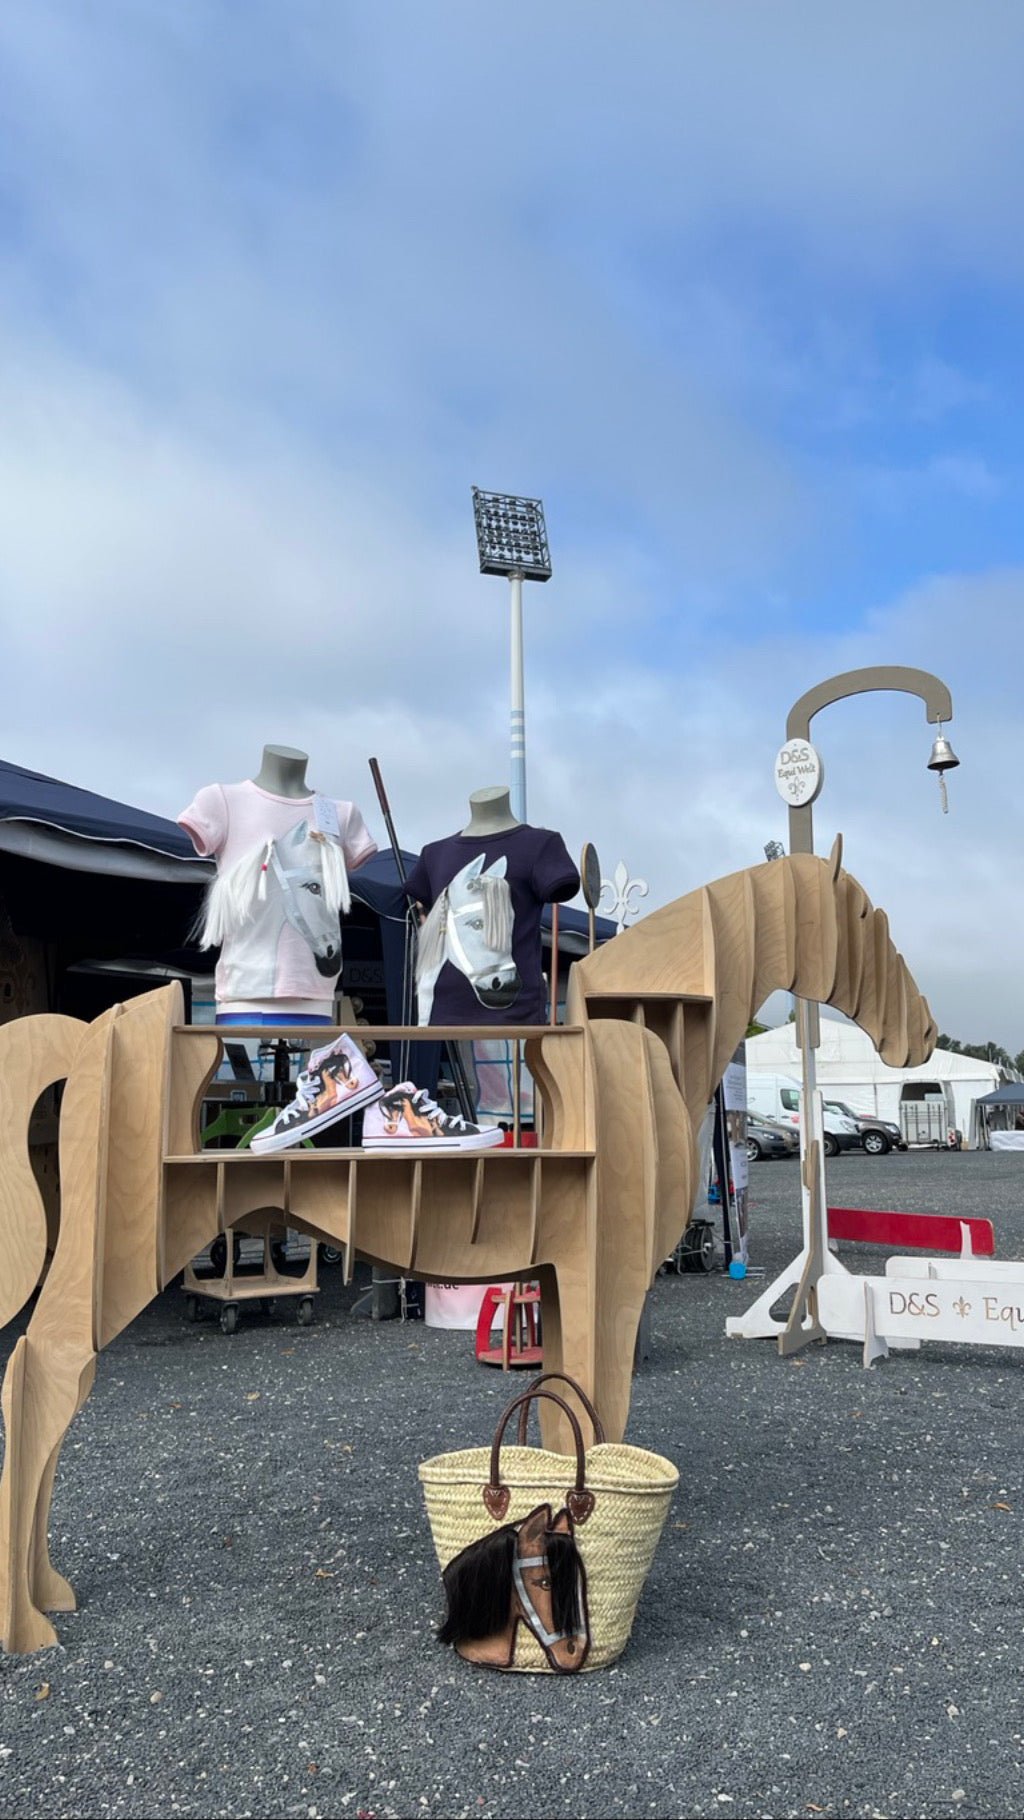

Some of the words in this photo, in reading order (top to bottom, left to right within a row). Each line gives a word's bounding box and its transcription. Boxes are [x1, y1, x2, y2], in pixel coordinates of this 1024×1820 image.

[780, 747, 810, 765] D&S
[777, 768, 796, 780] Equi
[796, 763, 816, 775] Welt
[889, 1291, 941, 1318] D&S
